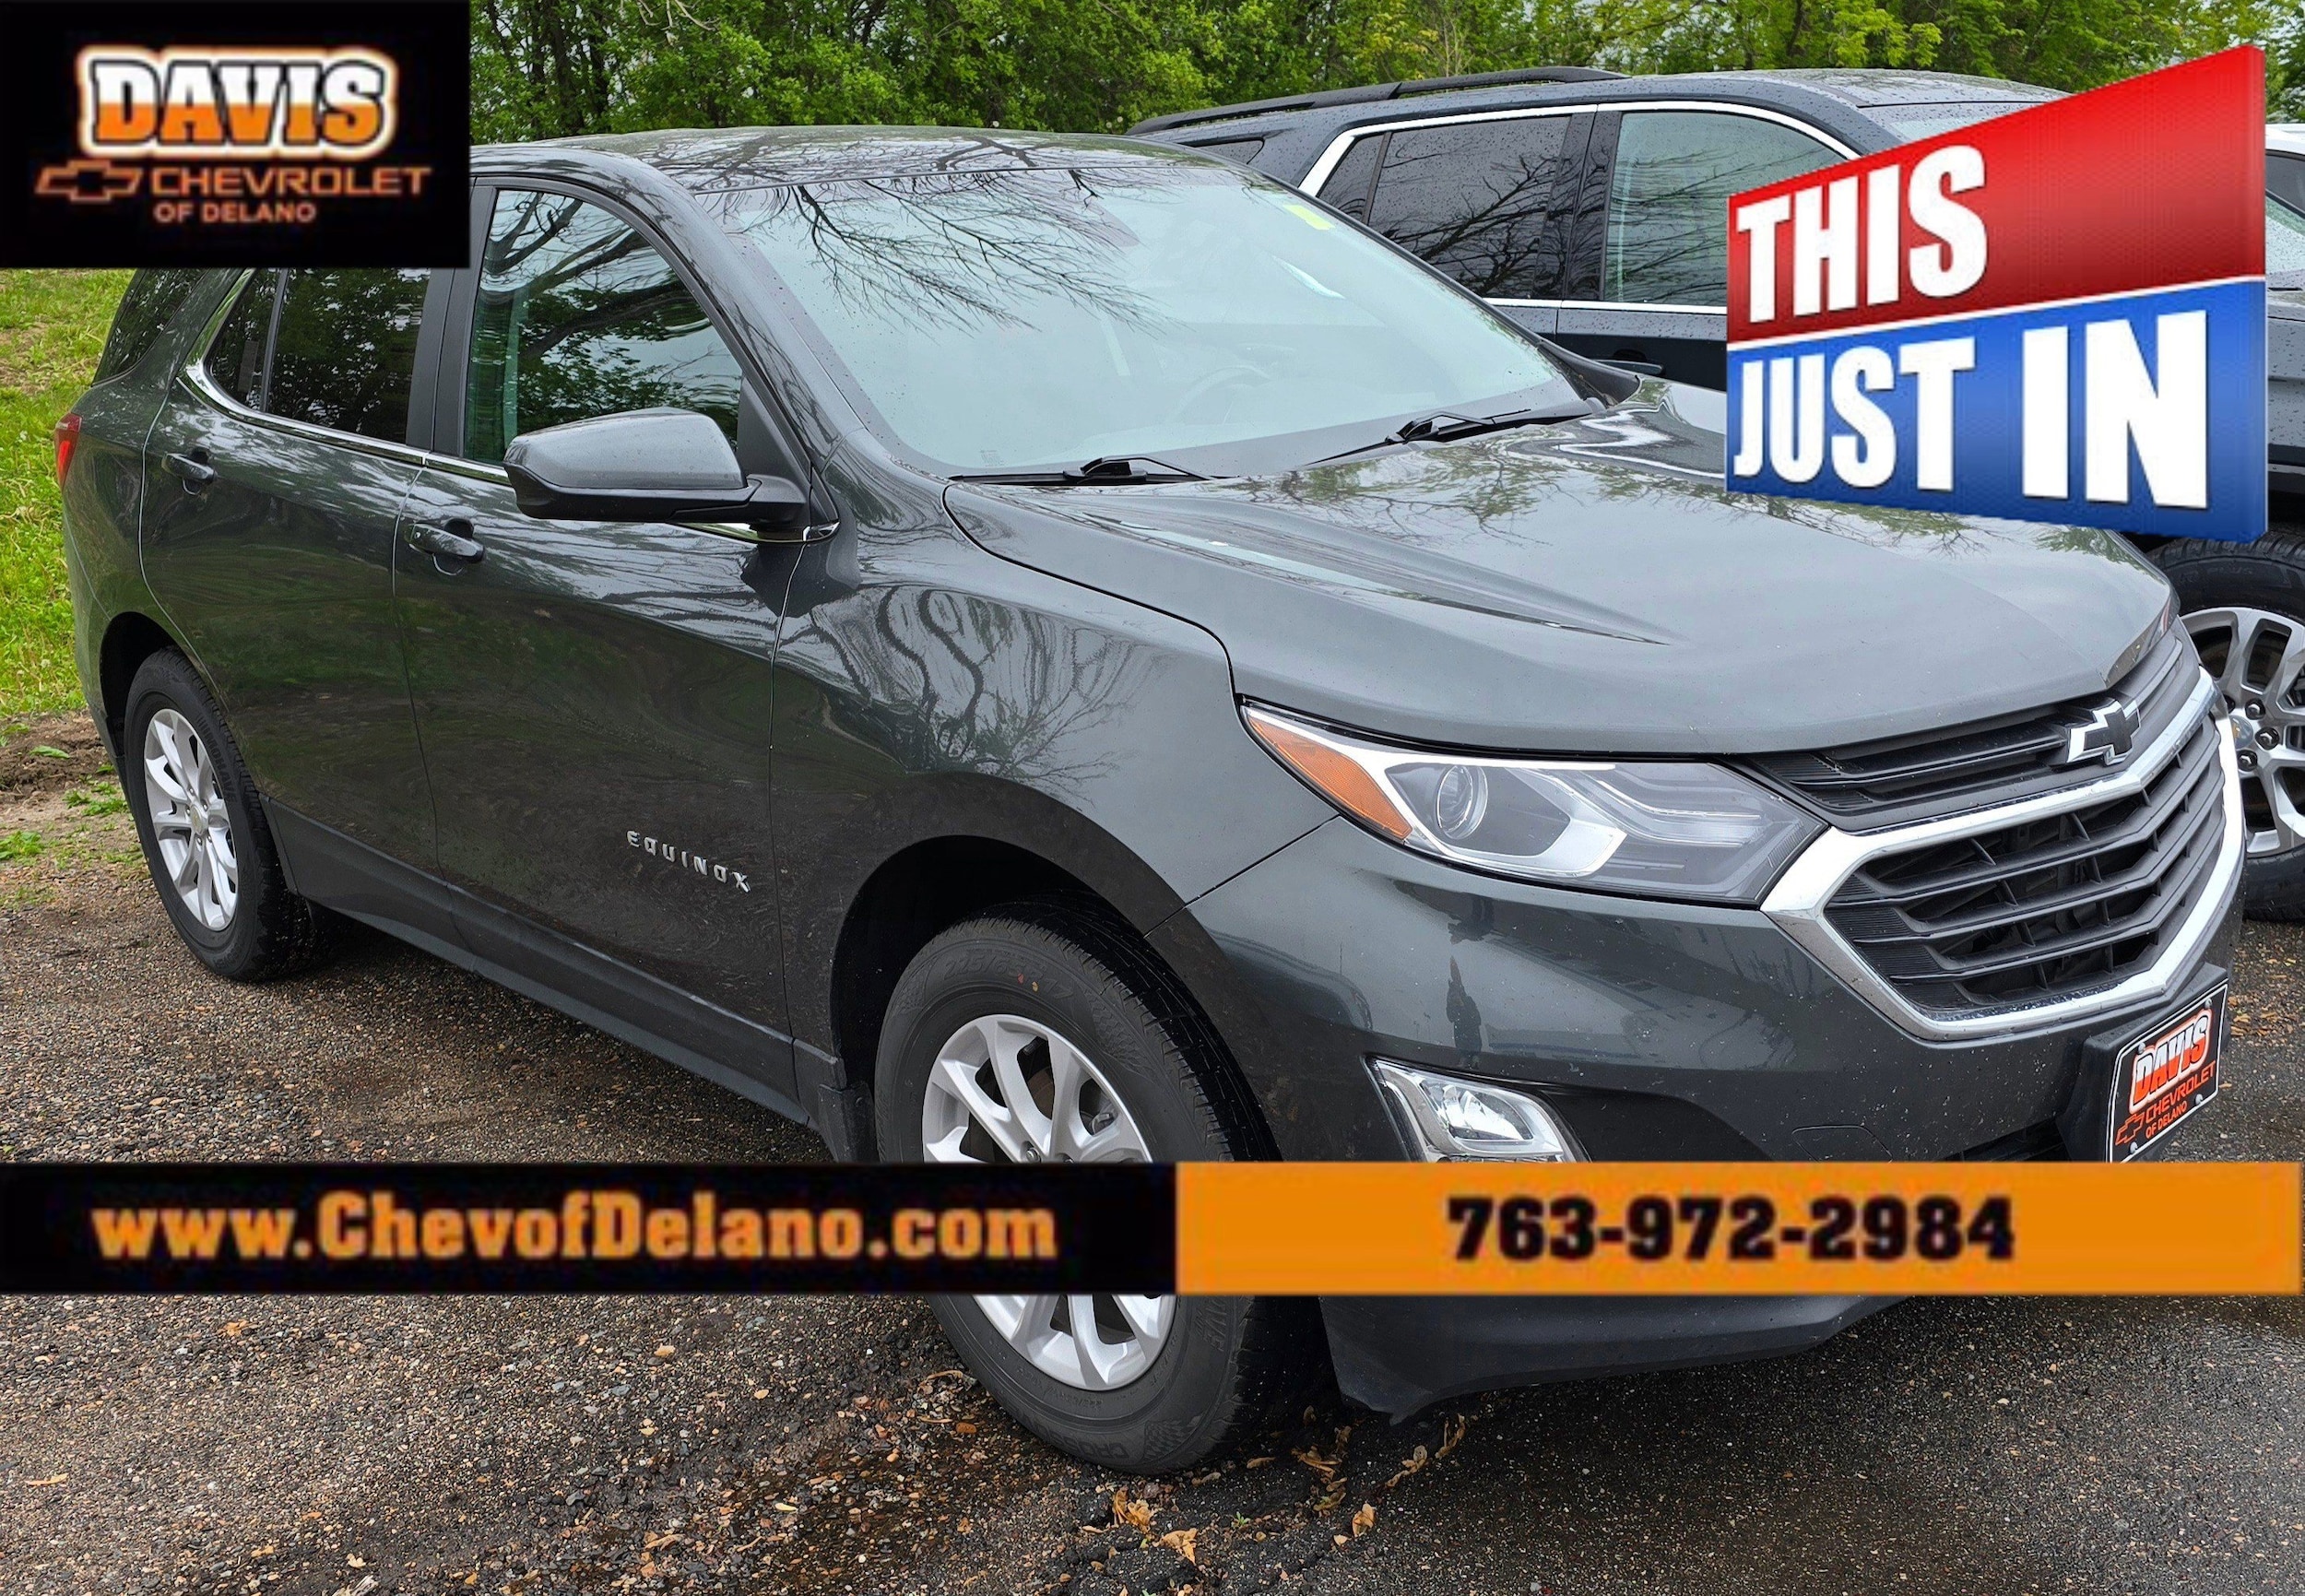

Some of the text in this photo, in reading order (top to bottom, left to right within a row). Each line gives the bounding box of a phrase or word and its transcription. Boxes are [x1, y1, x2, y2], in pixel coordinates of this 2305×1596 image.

[626, 830, 751, 893] EQUINOX
[2133, 1014, 2209, 1106] DAVIS
[2145, 1060, 2216, 1124] CHEVROLET
[2145, 1100, 2188, 1139] OF DELANO
